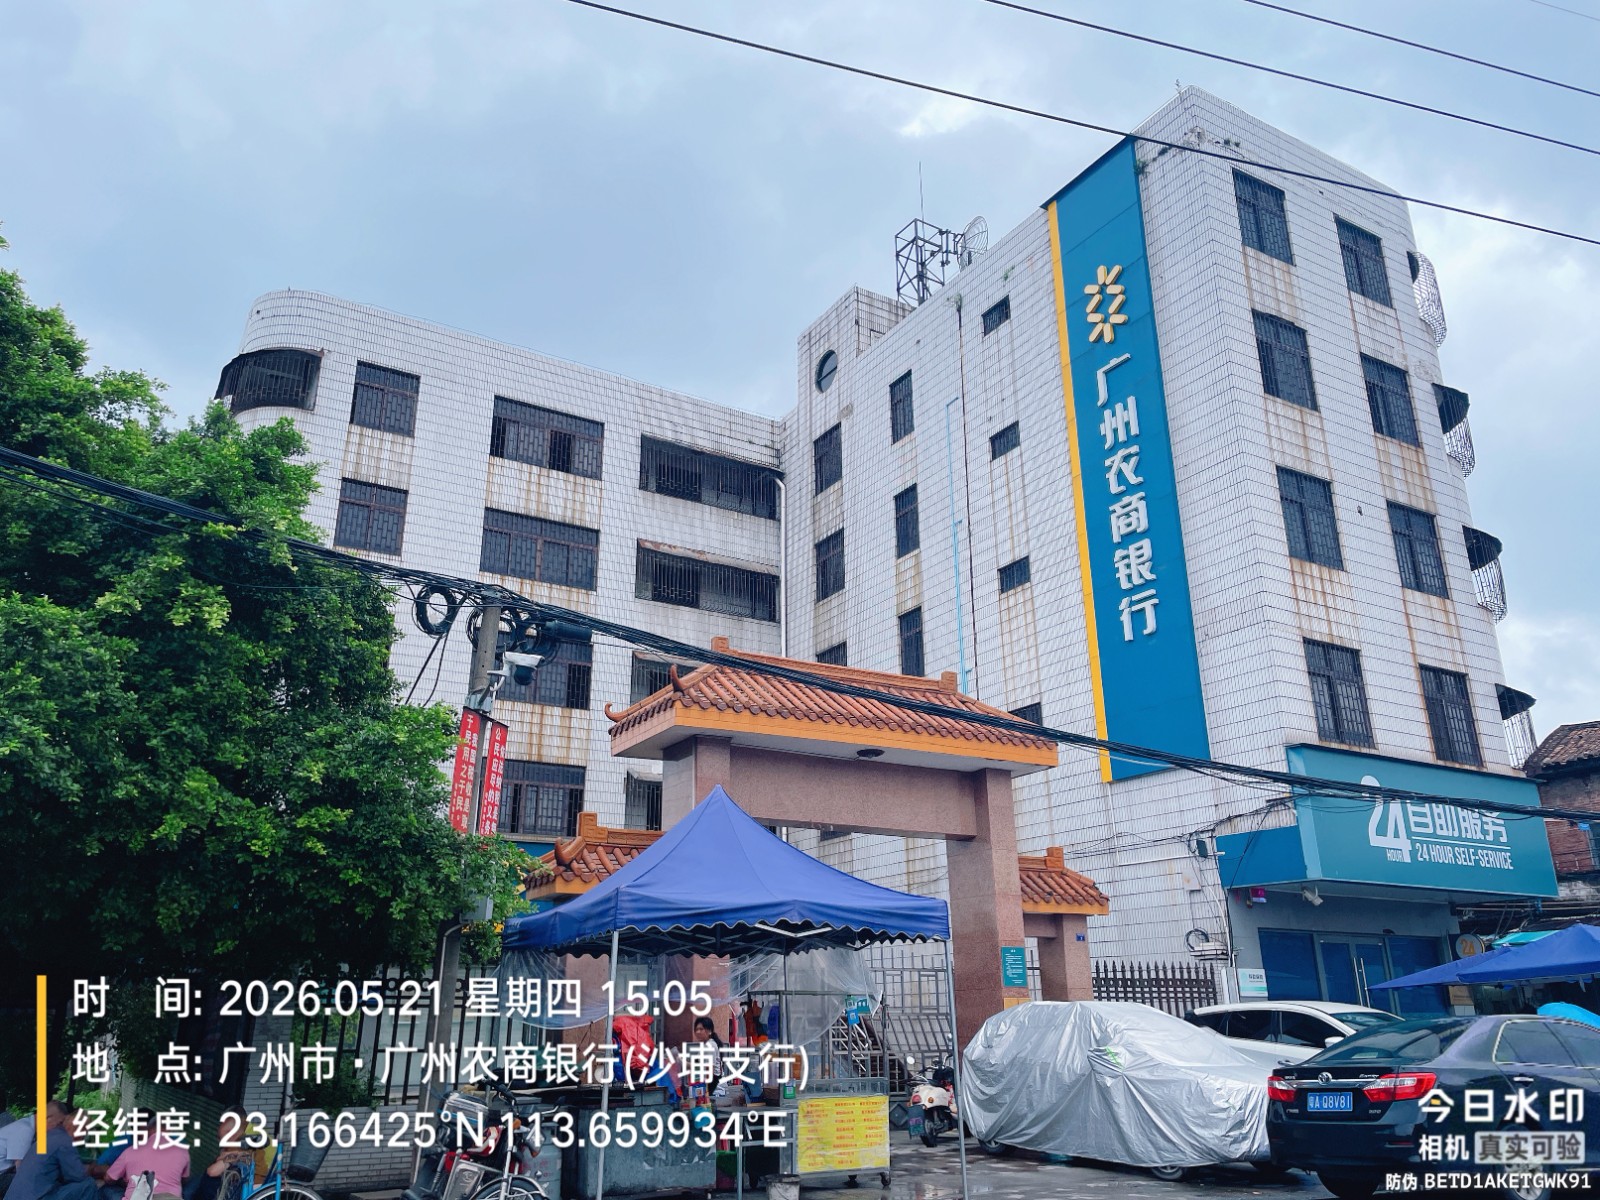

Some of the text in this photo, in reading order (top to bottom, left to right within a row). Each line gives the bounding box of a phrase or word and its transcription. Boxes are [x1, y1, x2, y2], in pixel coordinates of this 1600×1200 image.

[1096, 353, 1159, 641] 广州农商银行
[1406, 800, 1508, 842] 自助服务
[1416, 843, 1514, 870] 24 HOUR SELF-SERVICE
